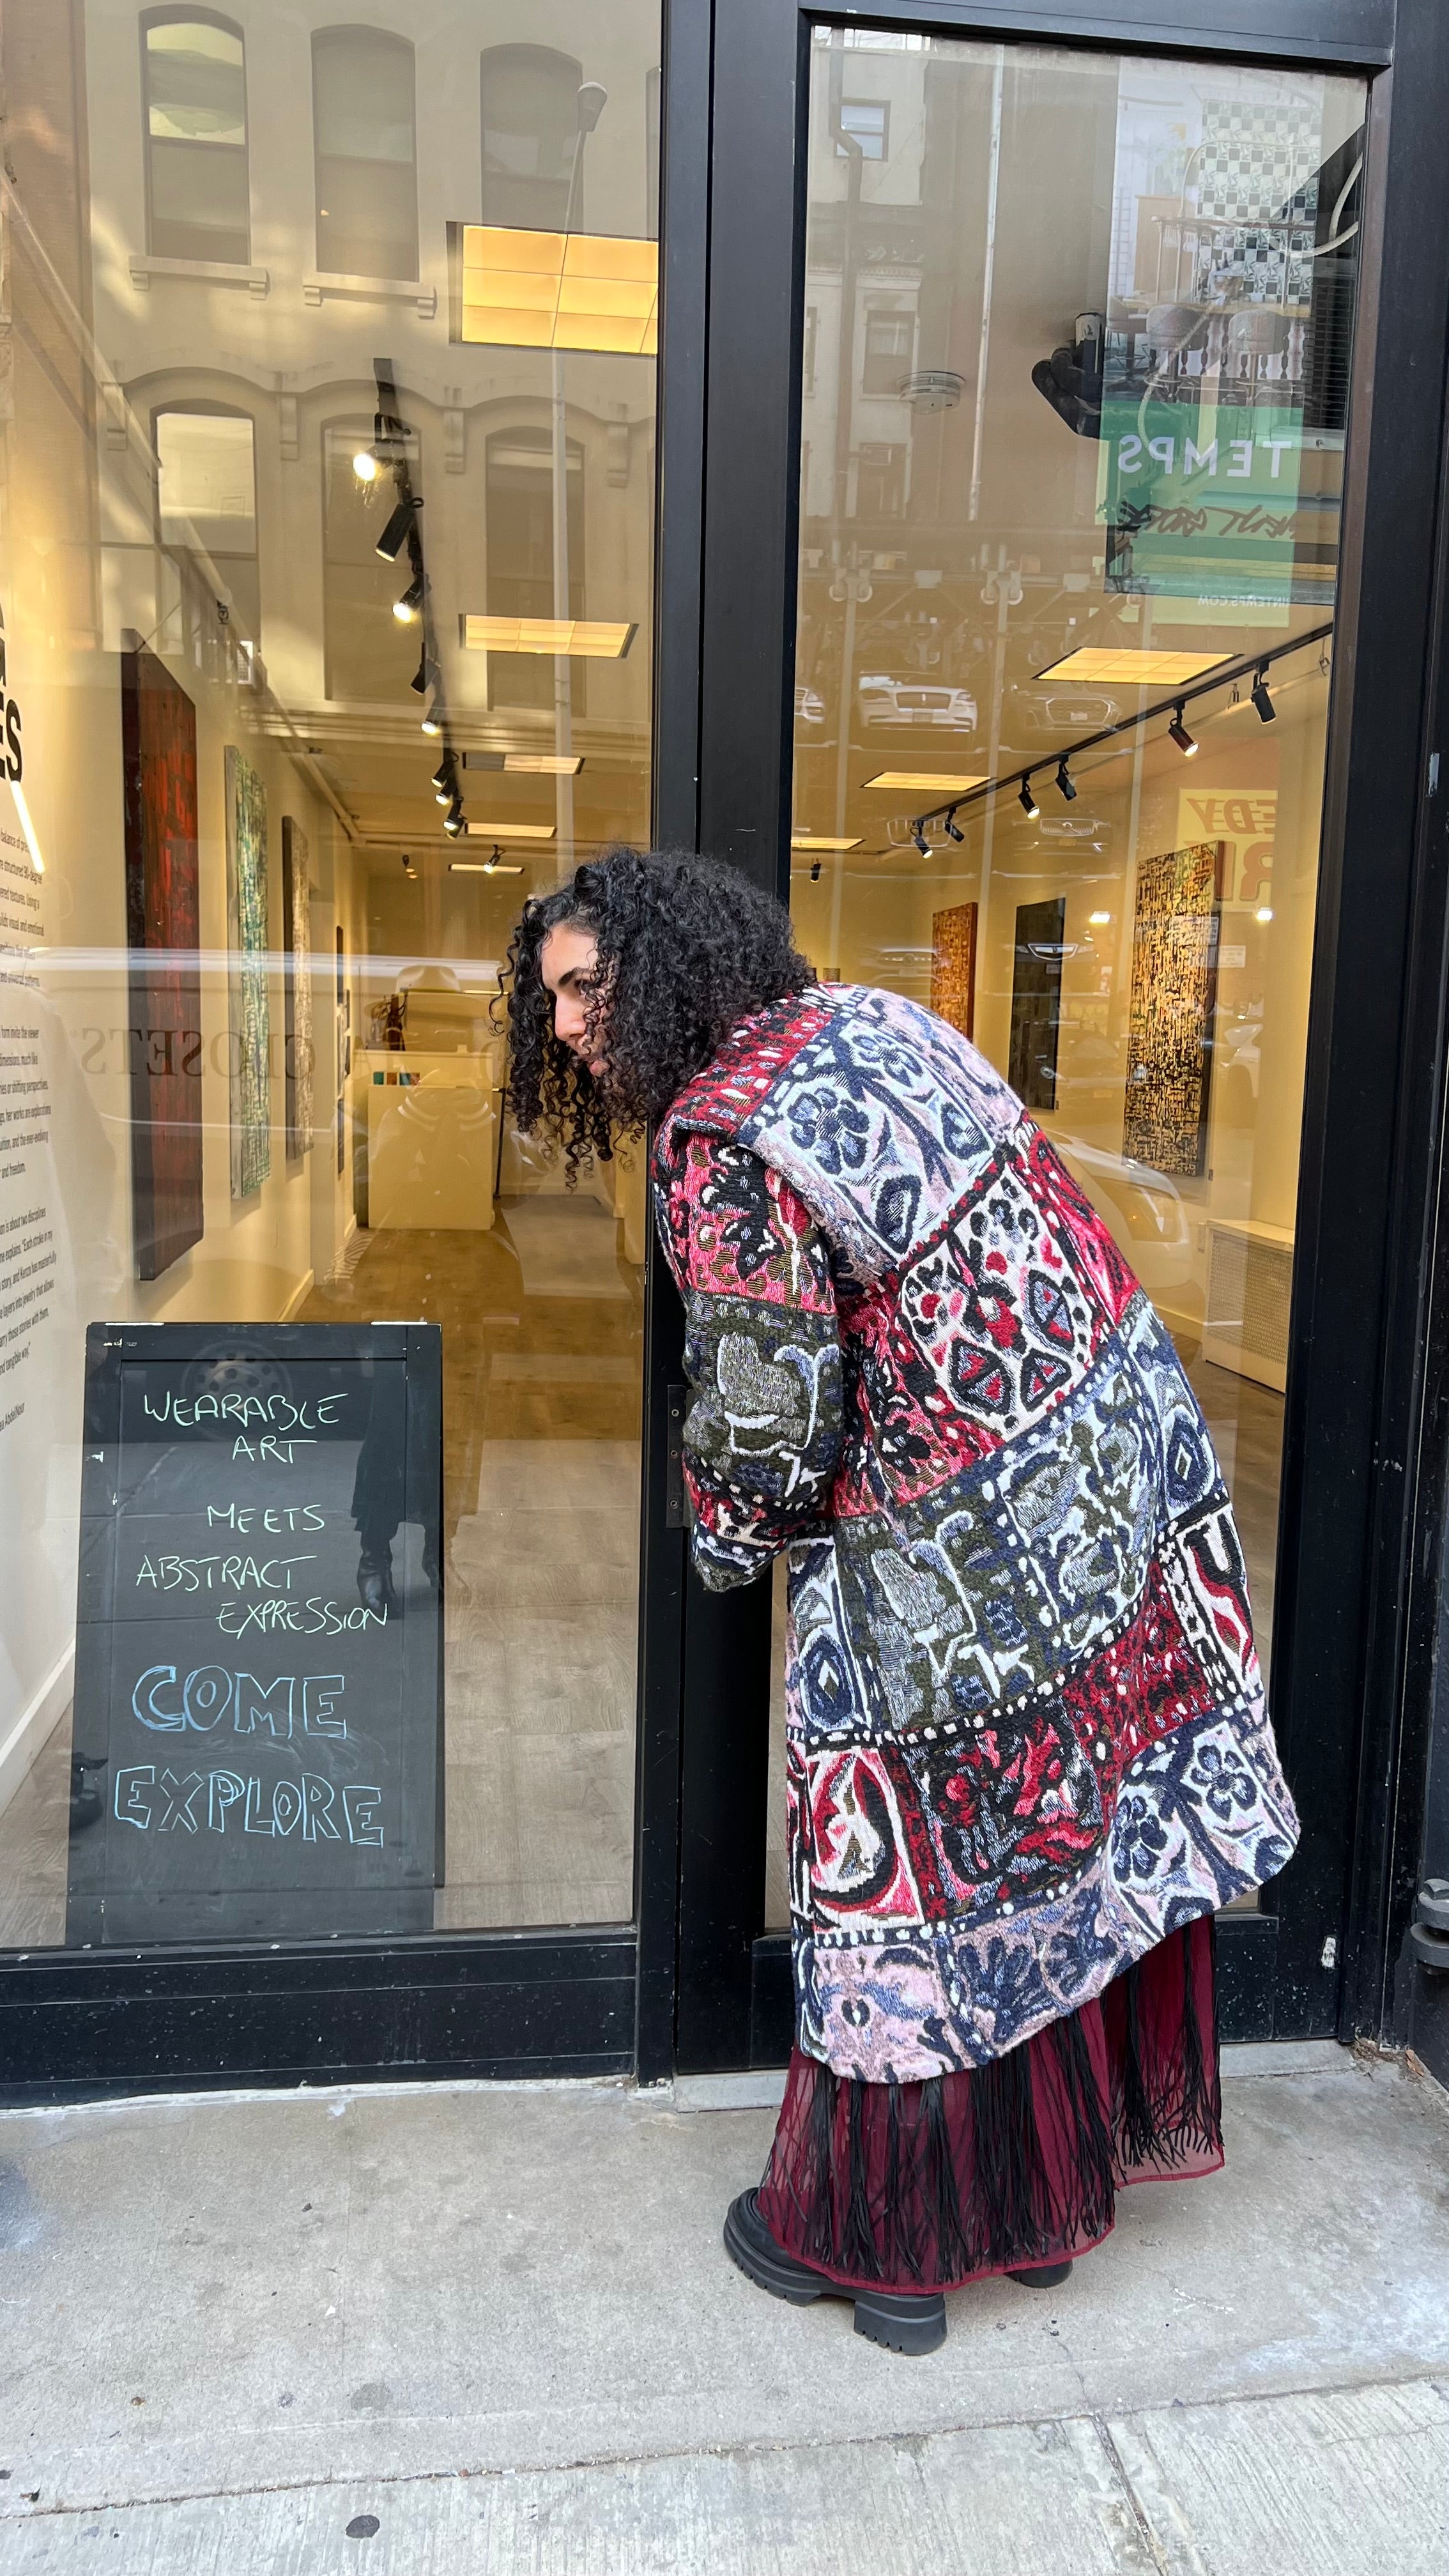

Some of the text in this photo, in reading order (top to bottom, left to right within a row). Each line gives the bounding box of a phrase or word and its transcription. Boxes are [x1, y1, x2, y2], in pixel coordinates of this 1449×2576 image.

[10, 1216, 20, 1231] about
[6, 1349, 21, 1371] tangible
[144, 1390, 349, 1430] WEARABLE
[231, 1435, 318, 1464] ART
[206, 1503, 325, 1533] MEETS
[135, 1554, 318, 1591] ABSTRACT
[215, 1597, 388, 1640] EXPRESSION
[132, 1665, 348, 1739] COME
[114, 1765, 385, 1849] EXPLORE
